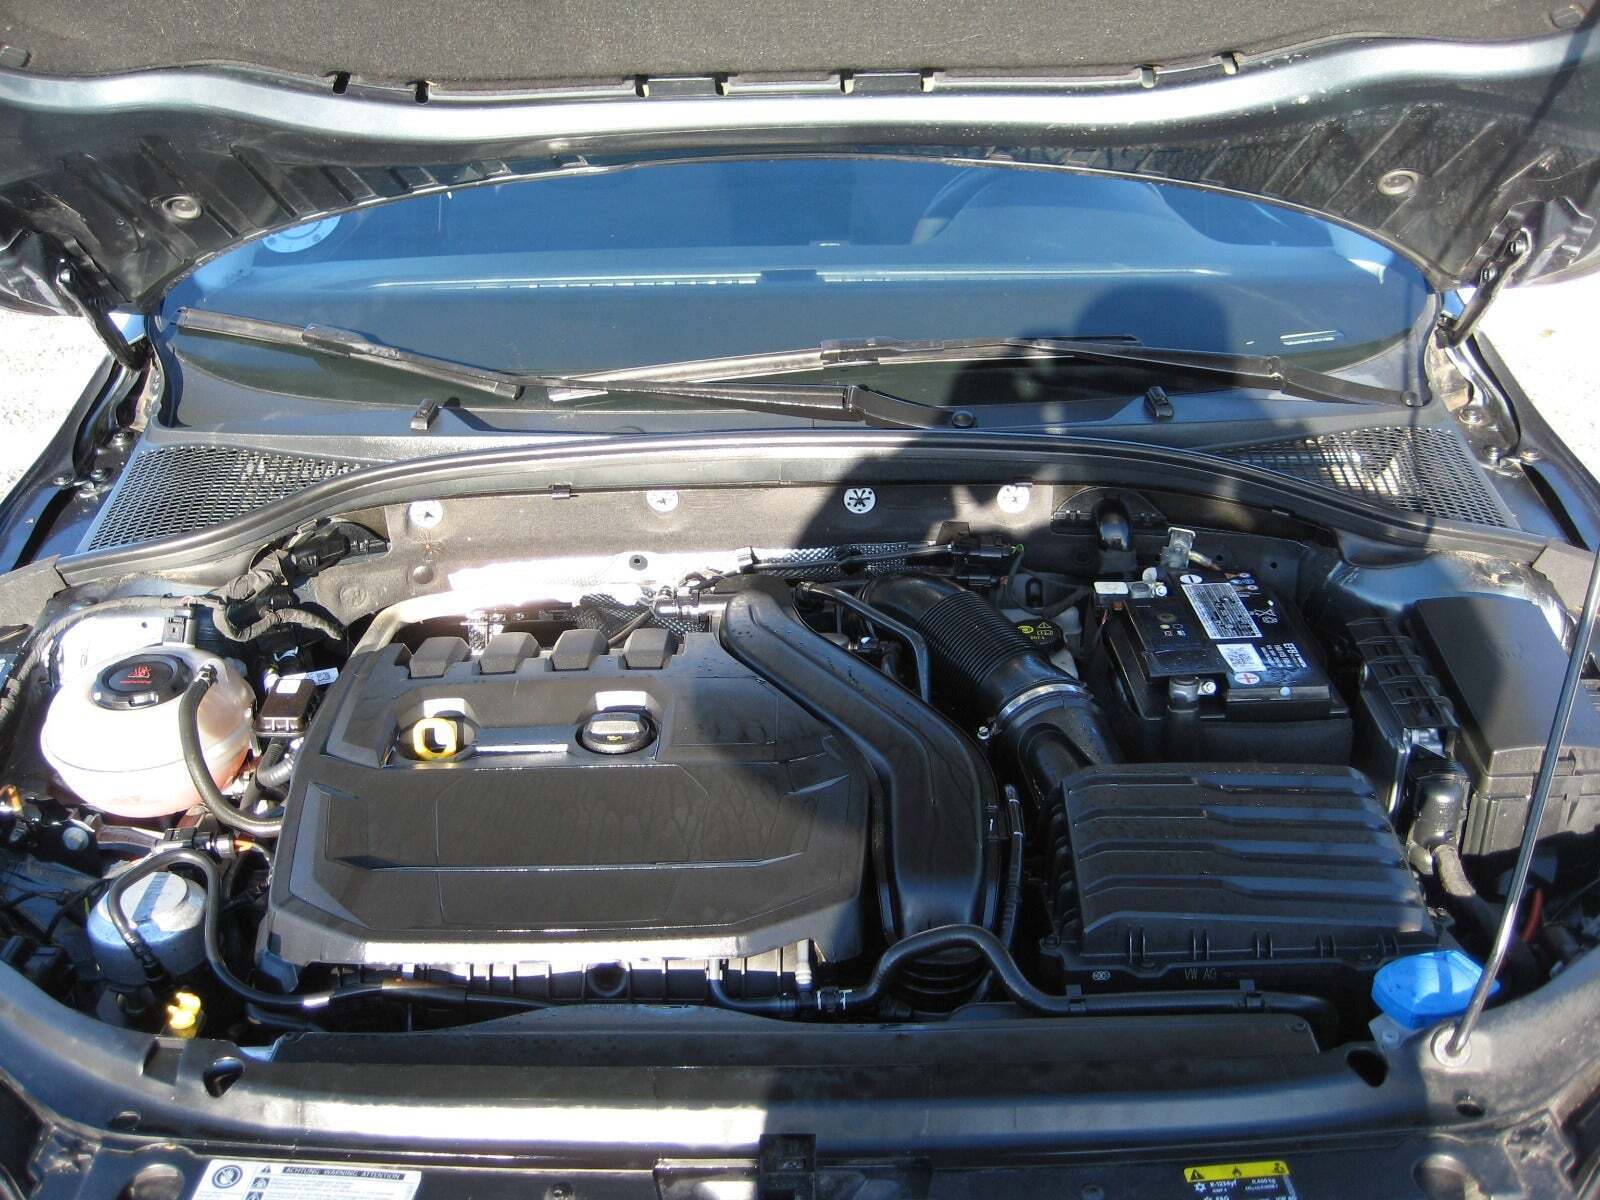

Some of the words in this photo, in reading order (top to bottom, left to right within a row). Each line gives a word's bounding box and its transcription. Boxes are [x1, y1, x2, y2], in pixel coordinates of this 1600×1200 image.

[1184, 967, 1198, 980] VW
[1203, 967, 1216, 980] AG
[324, 1168, 357, 1177] WARNING
